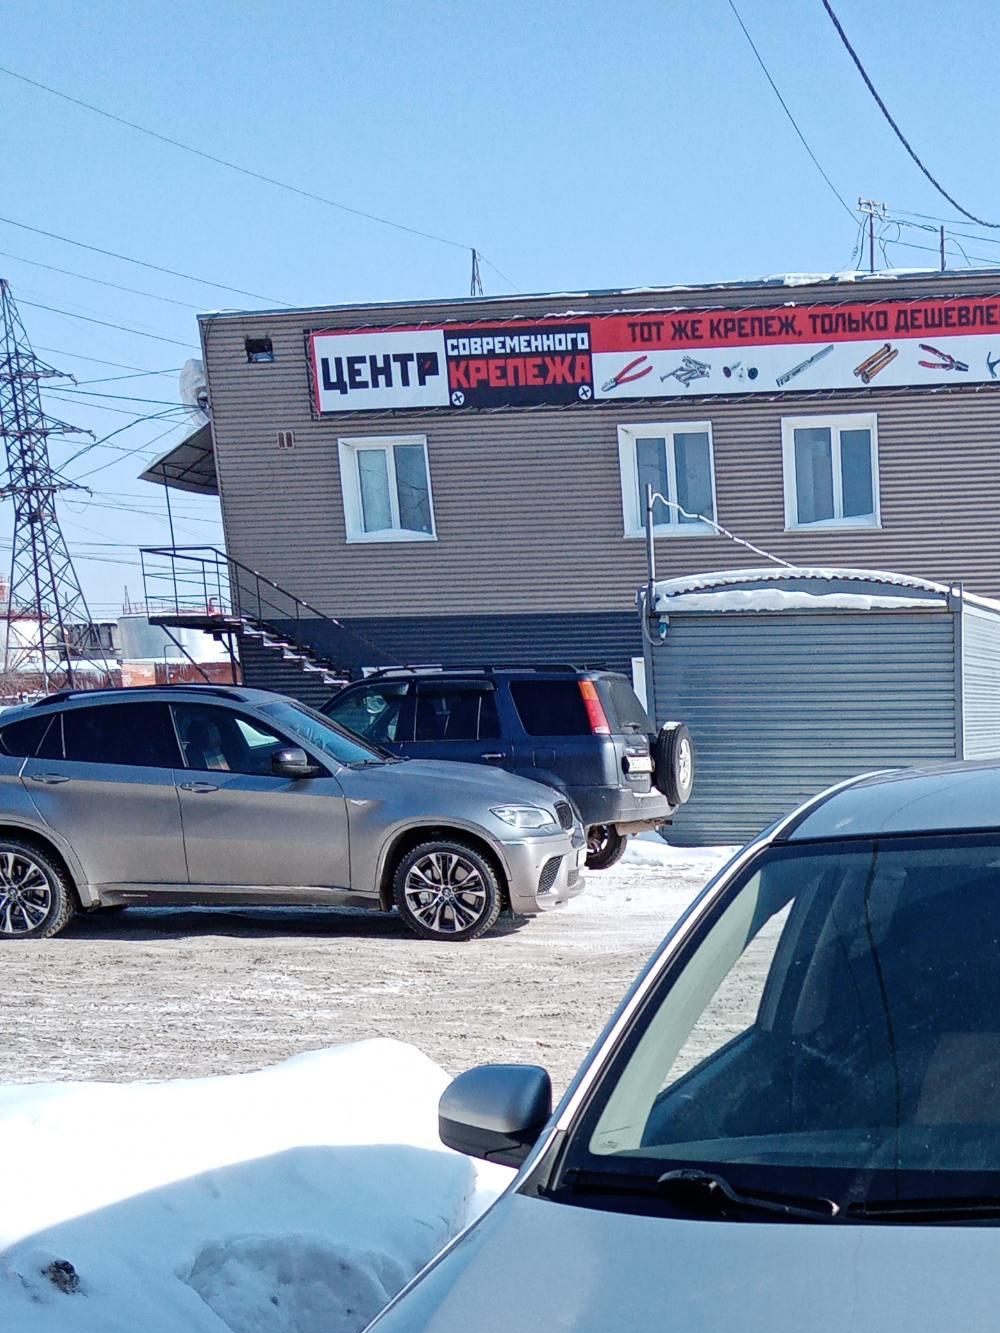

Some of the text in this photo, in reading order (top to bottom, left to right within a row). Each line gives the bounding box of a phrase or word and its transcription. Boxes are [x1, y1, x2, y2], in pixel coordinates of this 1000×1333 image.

[627, 320, 664, 343] ТОТ
[671, 319, 702, 341] ЖЕ
[709, 315, 802, 339] КРЕПЕЖ,
[809, 309, 889, 335] ТОЛЬКО
[446, 332, 589, 356] СОВРЕМЕННОГО
[321, 351, 440, 395] ЦЕНТР
[449, 354, 592, 390] КРЕПЕЖА
